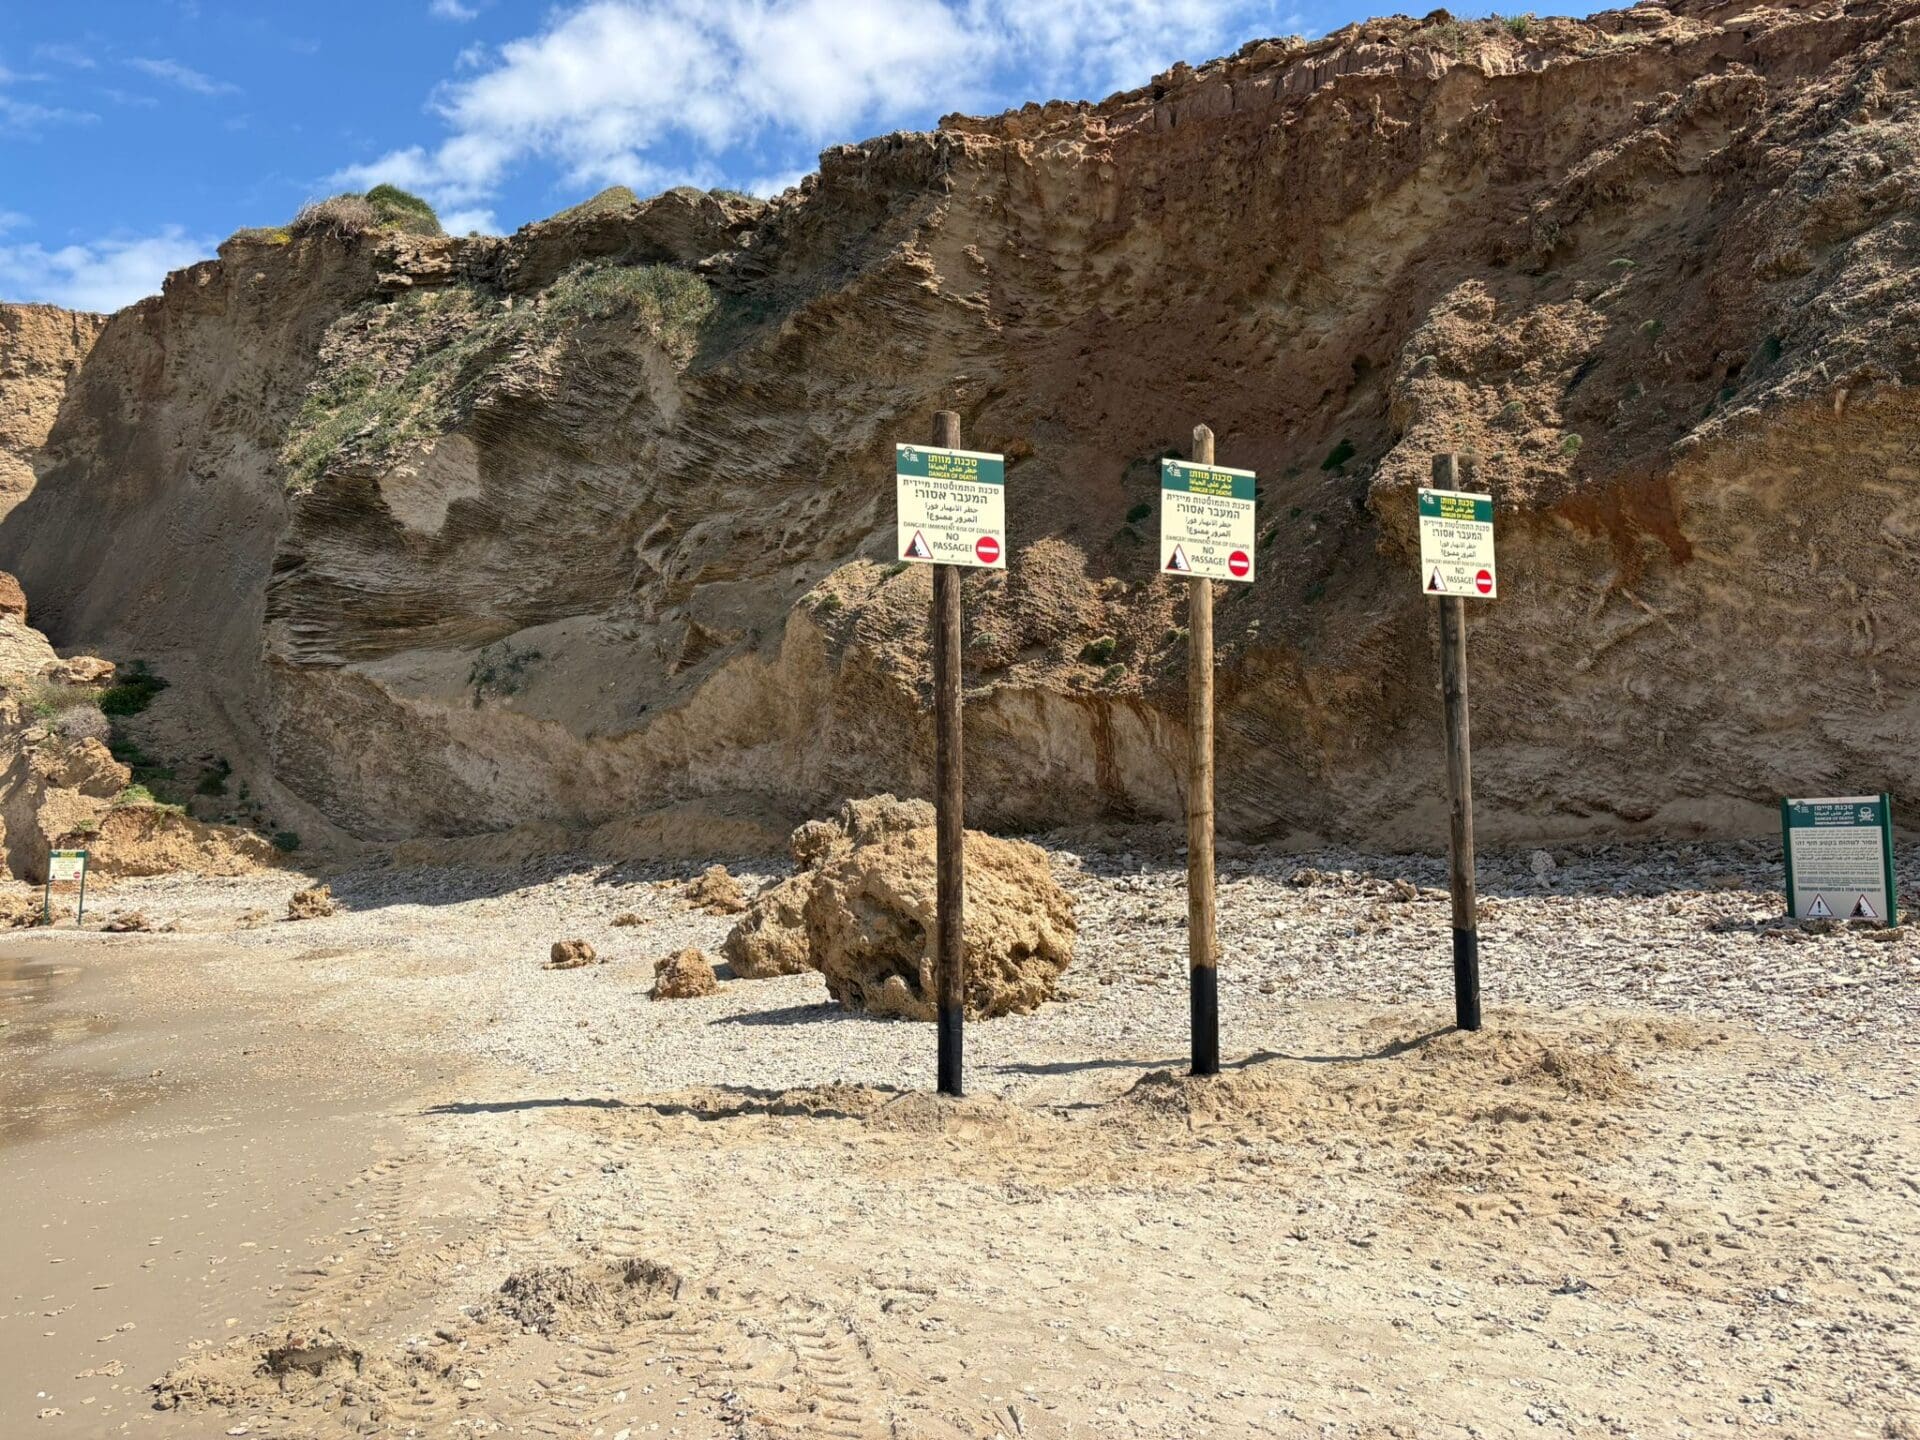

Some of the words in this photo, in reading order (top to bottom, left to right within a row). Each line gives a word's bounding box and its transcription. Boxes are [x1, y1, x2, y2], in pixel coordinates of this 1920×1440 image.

[928, 455, 951, 464] מוות!
[954, 458, 977, 466] סכנת
[1189, 470, 1209, 479] מוות!
[1212, 473, 1232, 482] סכנת
[903, 479, 930, 488] מיידית
[934, 482, 976, 492] התמוטטות
[915, 489, 946, 500] אסור!
[979, 486, 999, 494] סכנת
[950, 493, 988, 504] המעבר
[1166, 493, 1190, 502] מיידית
[1193, 497, 1230, 507] התמוטטות
[1177, 504, 1204, 515] אסור!
[1232, 502, 1250, 510] סכנת
[927, 512, 953, 521] ممنوع!
[1208, 507, 1240, 519] המעבר
[946, 533, 959, 541] NO
[1433, 529, 1454, 538] אסור!
[1456, 530, 1482, 540] המעבר
[933, 542, 972, 552] PASSAGE!
[1203, 546, 1214, 554] NO
[1191, 555, 1226, 565] PASSAGE!
[1447, 575, 1474, 584] PASSAGE!
